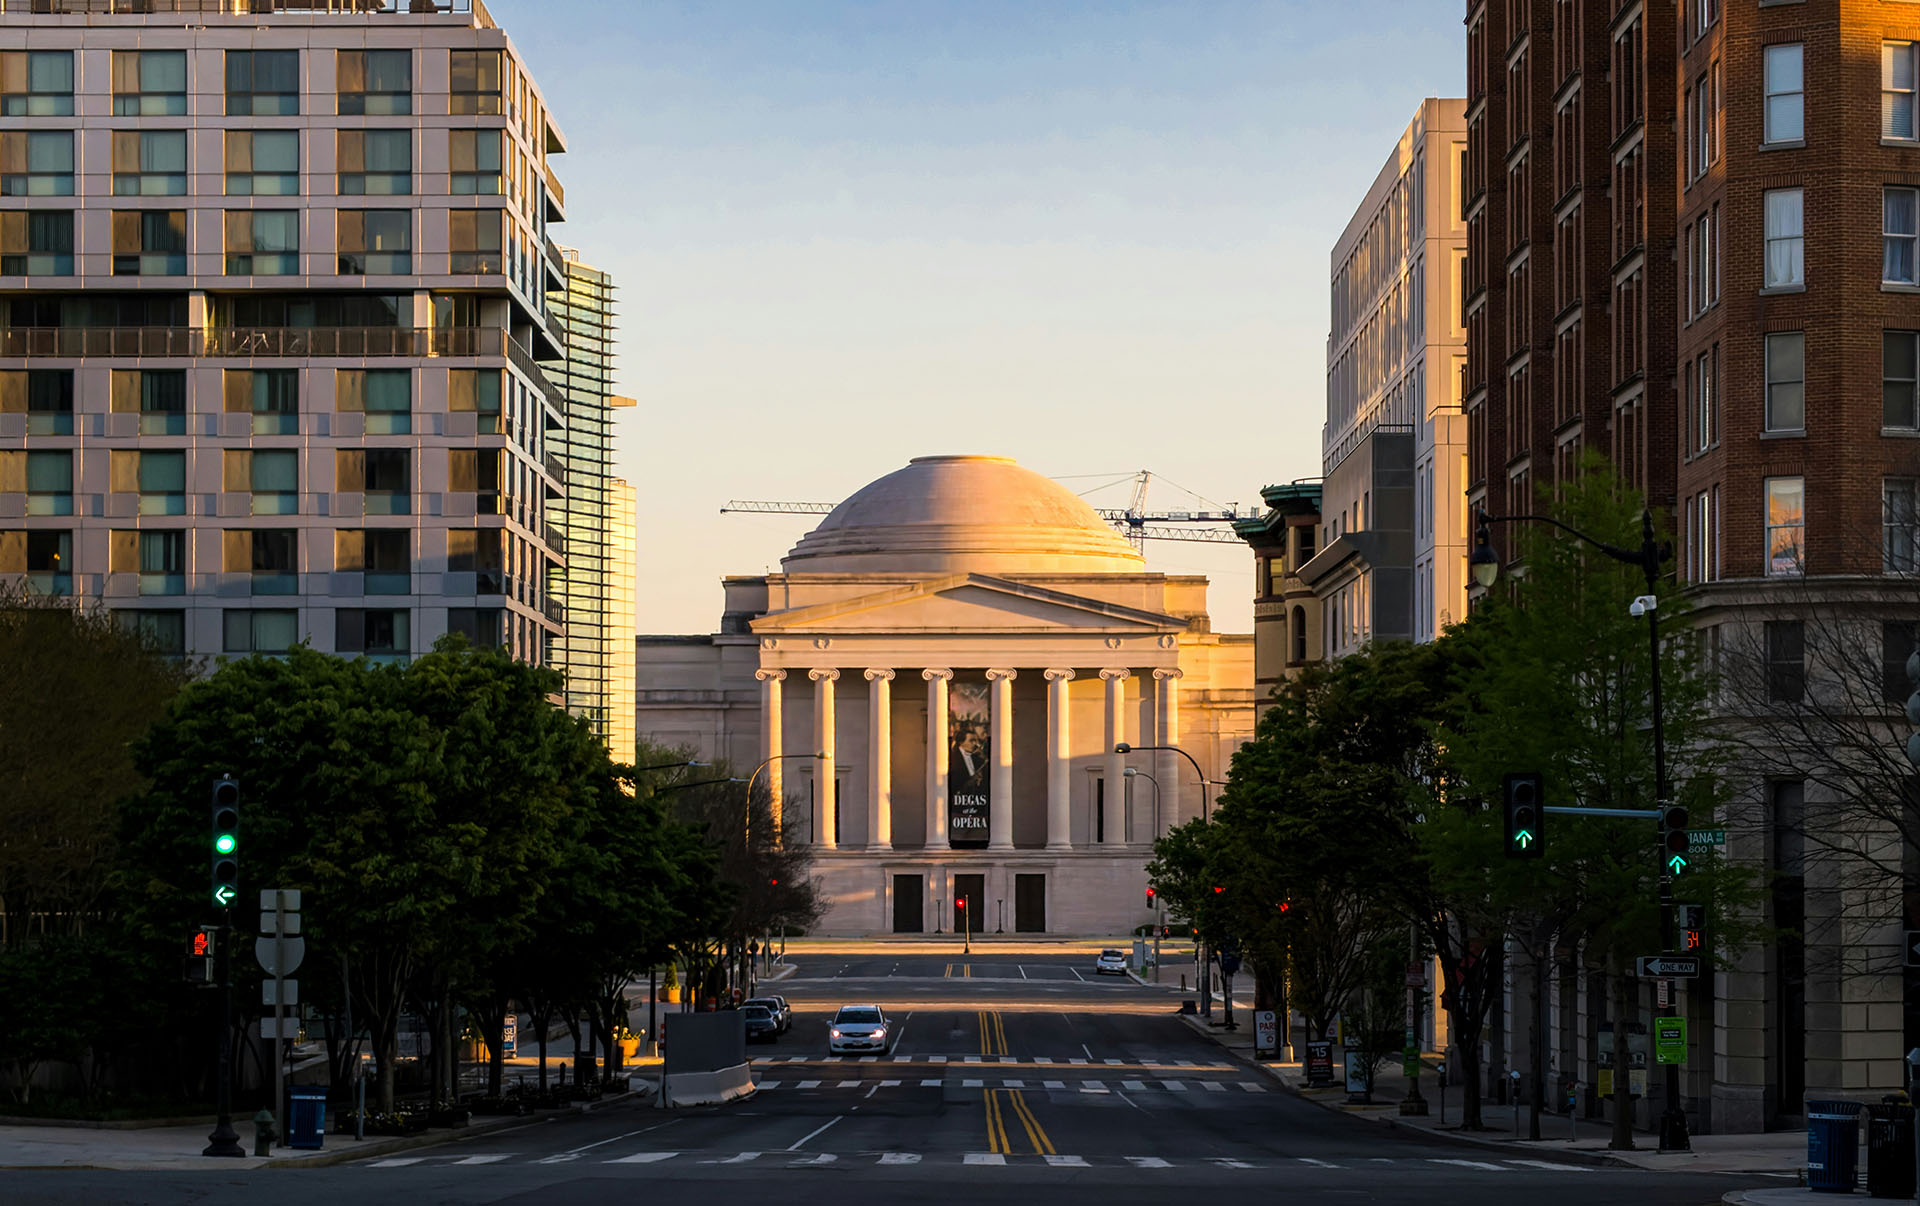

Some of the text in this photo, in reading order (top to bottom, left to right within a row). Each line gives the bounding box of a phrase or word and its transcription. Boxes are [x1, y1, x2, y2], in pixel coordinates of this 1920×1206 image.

[954, 795, 987, 806] DEGAS
[953, 815, 988, 829] OPÉRA
[1688, 832, 1714, 844] IANA
[1660, 963, 1693, 971] ONE WAY
